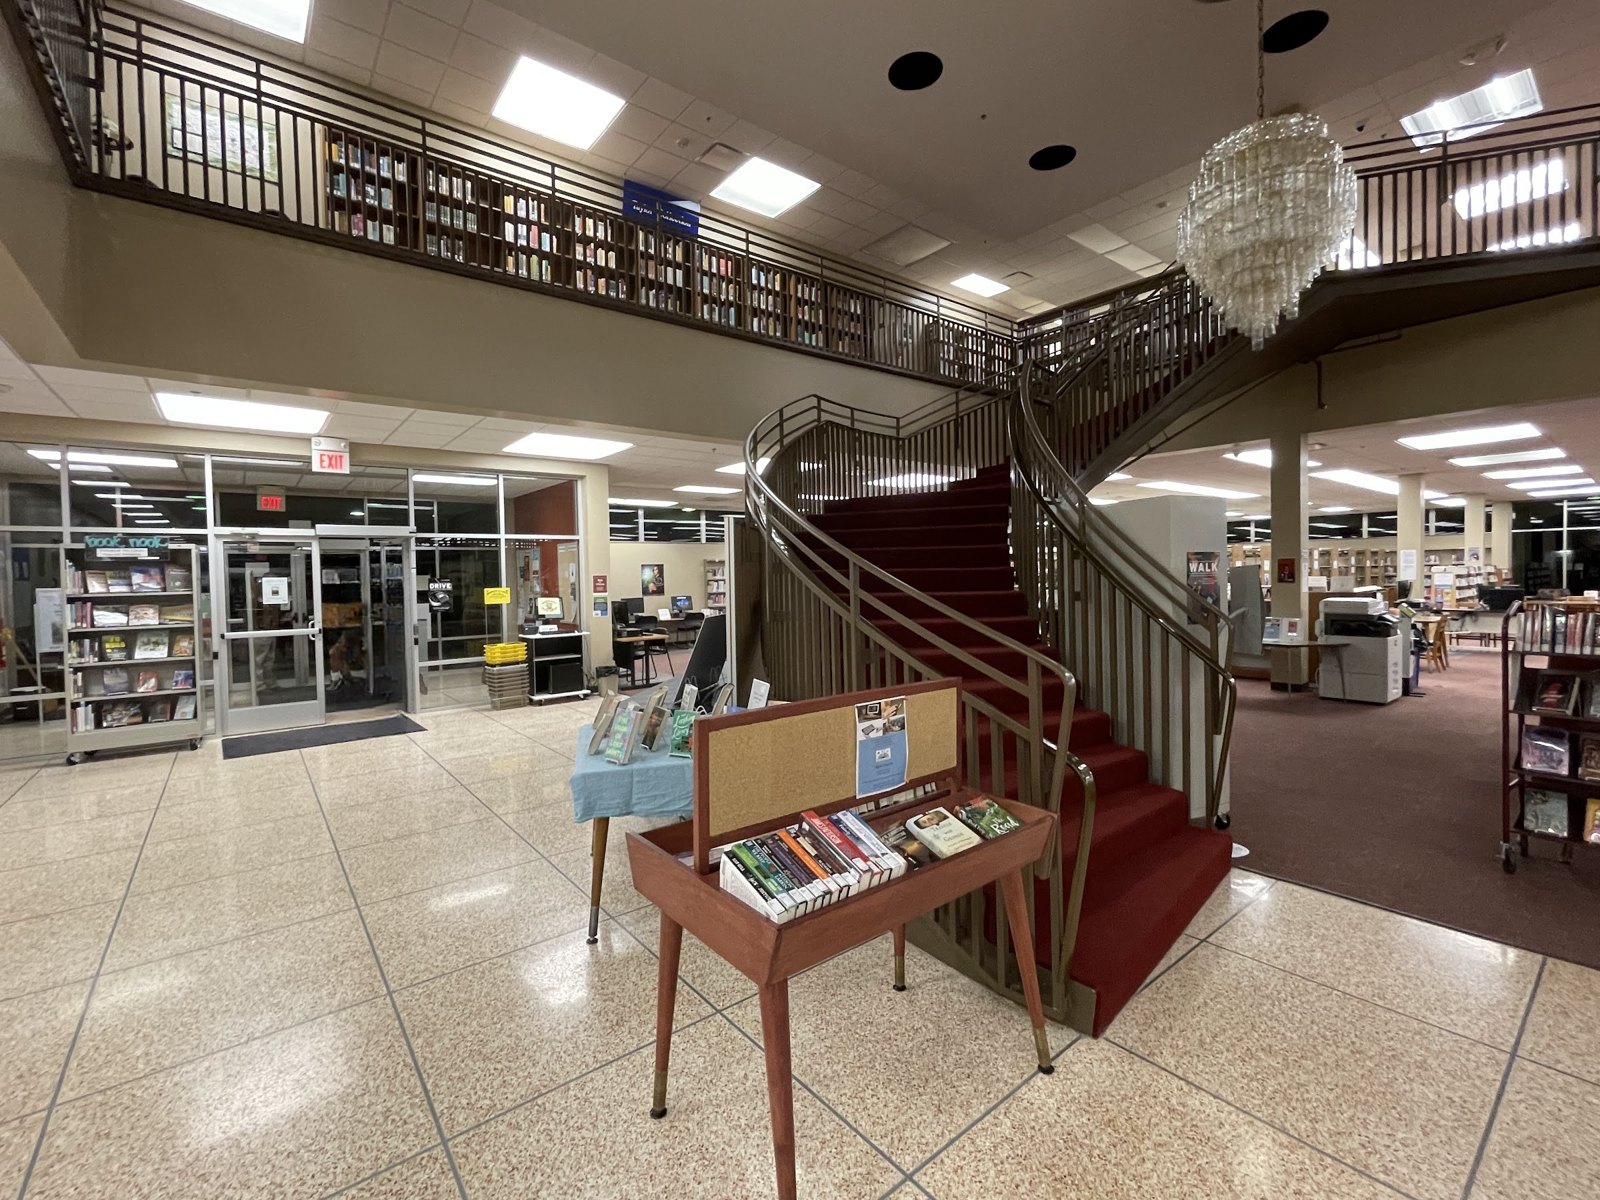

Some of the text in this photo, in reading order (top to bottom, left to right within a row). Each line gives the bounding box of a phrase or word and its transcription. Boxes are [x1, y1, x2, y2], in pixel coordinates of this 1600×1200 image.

[319, 453, 344, 470] EXIT
[261, 496, 282, 509] EXIT
[1189, 562, 1218, 573] WALK
